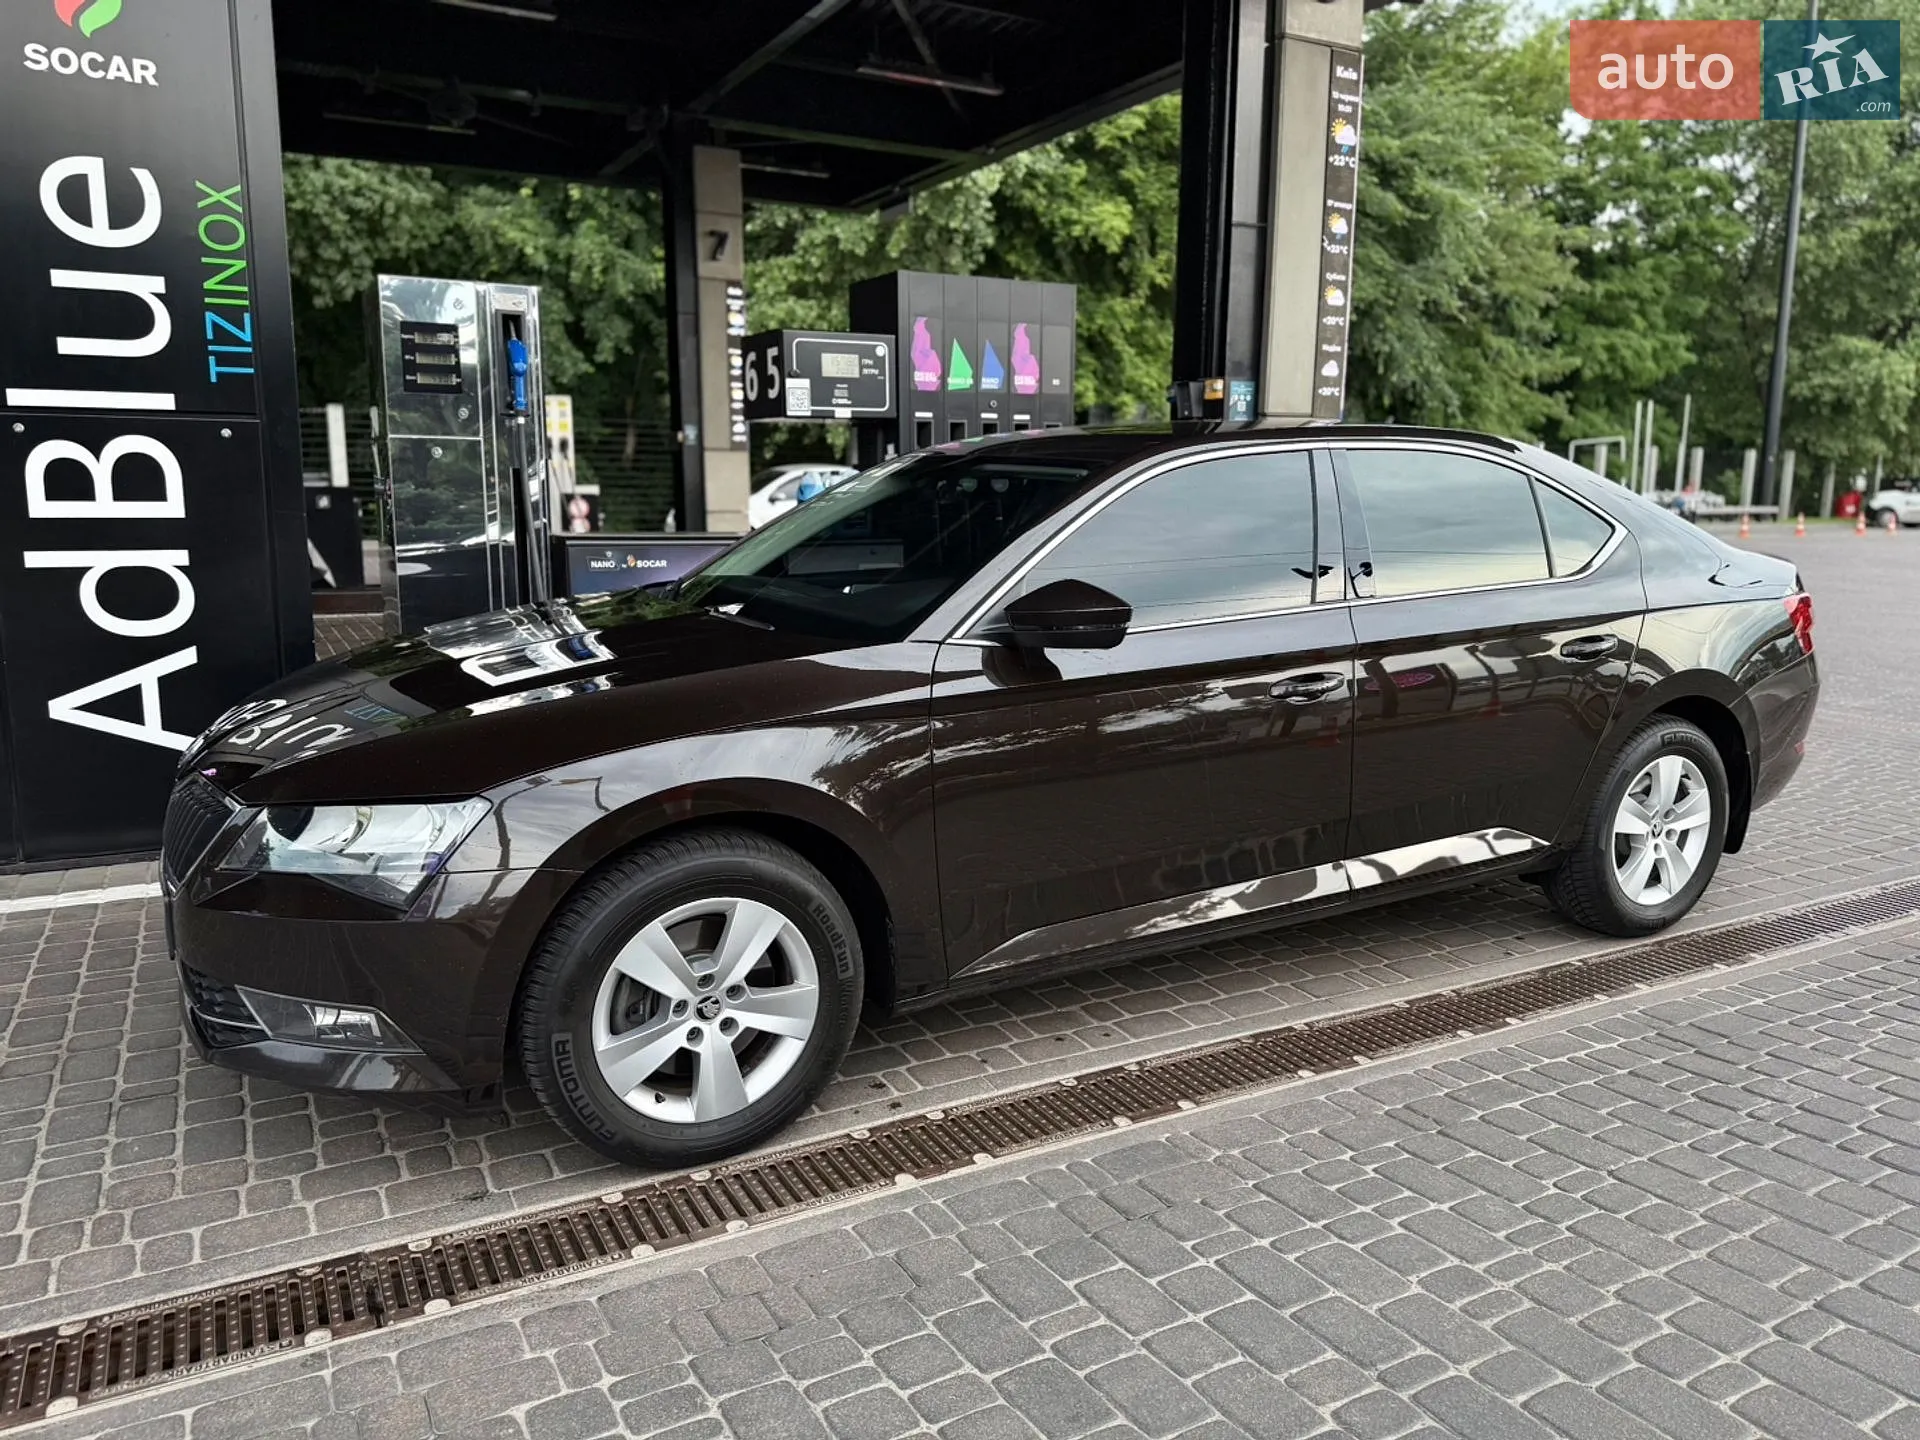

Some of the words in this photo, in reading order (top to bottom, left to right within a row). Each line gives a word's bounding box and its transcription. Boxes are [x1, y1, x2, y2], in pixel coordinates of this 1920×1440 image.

[23, 43, 158, 86] SOCAR
[702, 229, 729, 261] 7
[195, 180, 255, 383] TIZINOX
[745, 351, 758, 402] 6
[767, 346, 780, 399] 5
[5, 155, 198, 752] AdBlue
[590, 560, 616, 569] NANO
[636, 559, 667, 569] SOCAR
[812, 903, 850, 975] RoadFun
[555, 1039, 617, 1140] FUNTOMA
